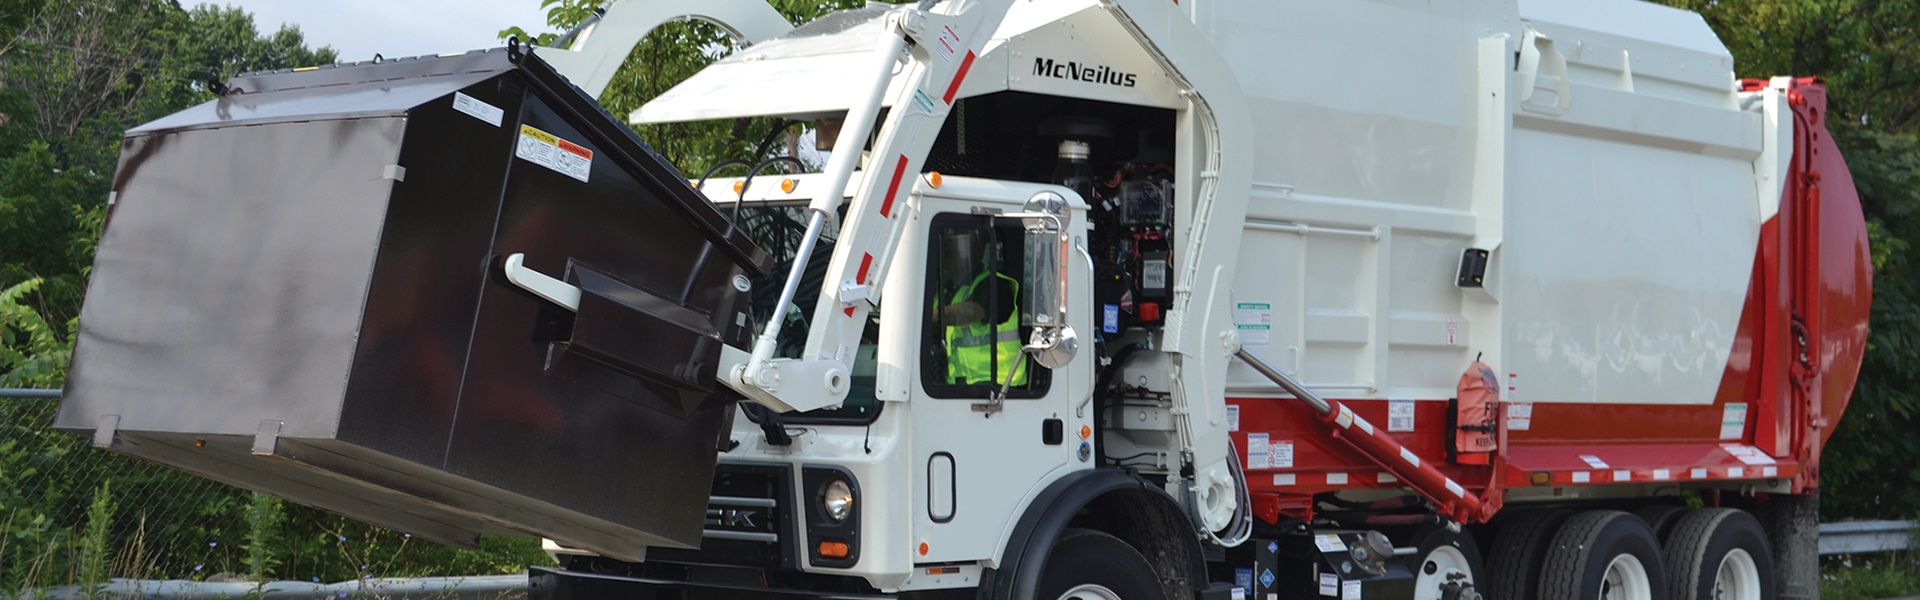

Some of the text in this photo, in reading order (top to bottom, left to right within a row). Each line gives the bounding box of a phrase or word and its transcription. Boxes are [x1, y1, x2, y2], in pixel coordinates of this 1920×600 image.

[1032, 57, 1137, 88] McNeilus
[527, 129, 556, 144] CAUTION
[562, 143, 590, 157] WARNING
